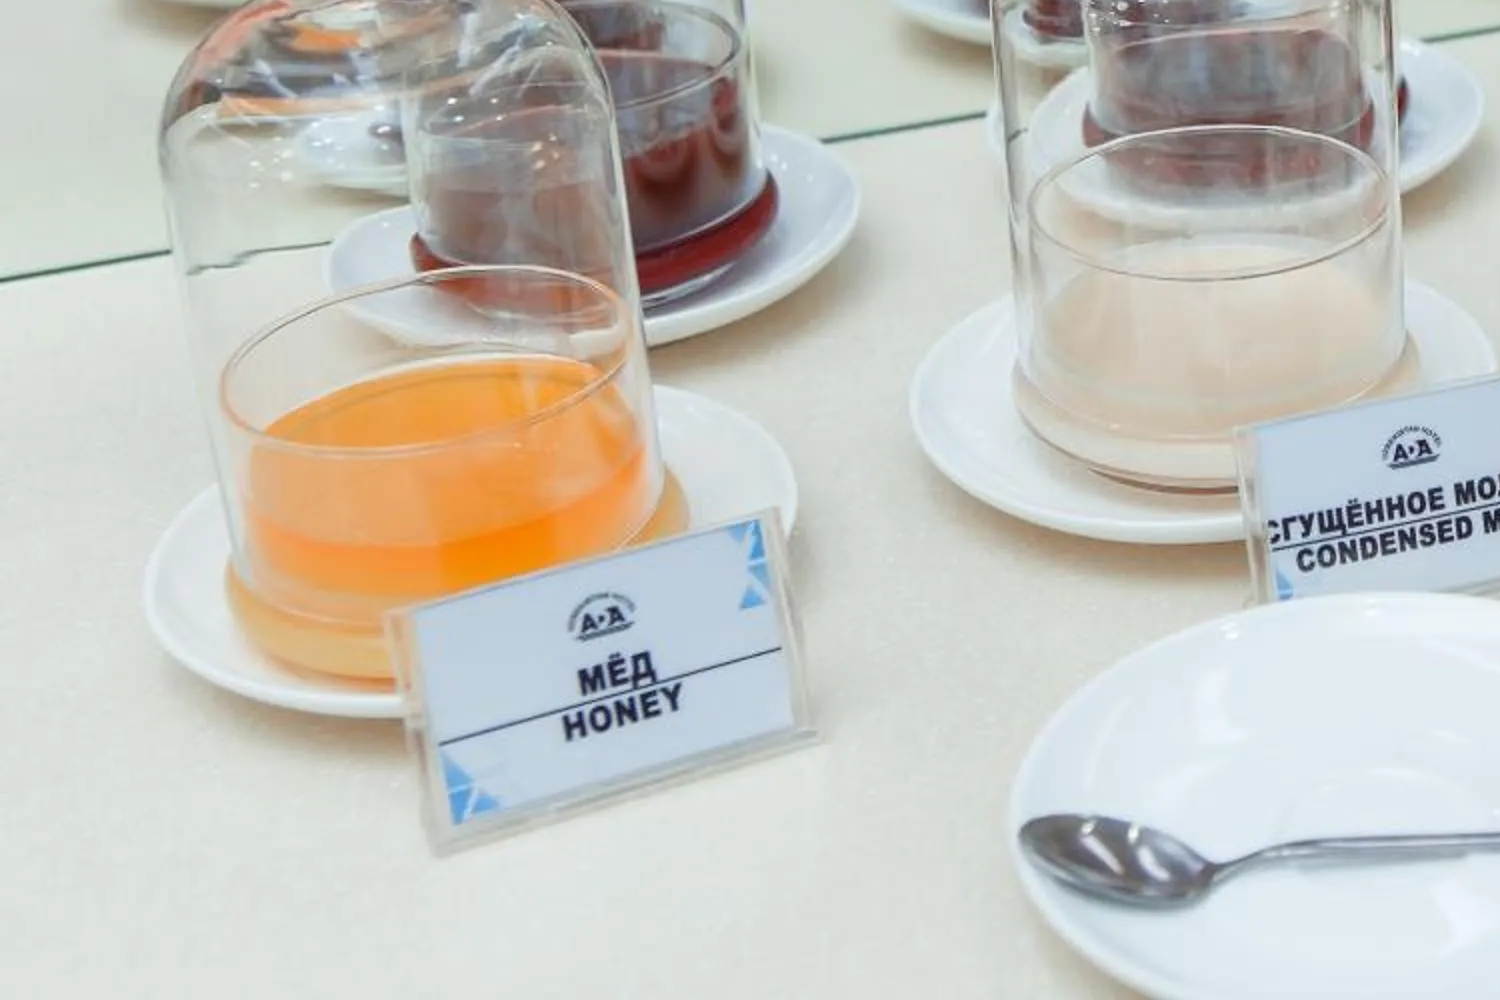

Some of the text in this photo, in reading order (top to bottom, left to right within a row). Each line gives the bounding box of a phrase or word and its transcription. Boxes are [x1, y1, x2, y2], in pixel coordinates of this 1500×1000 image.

[1296, 516, 1473, 572] CONDENSED
[577, 650, 658, 696] МЁД
[562, 683, 682, 742] HONEY
